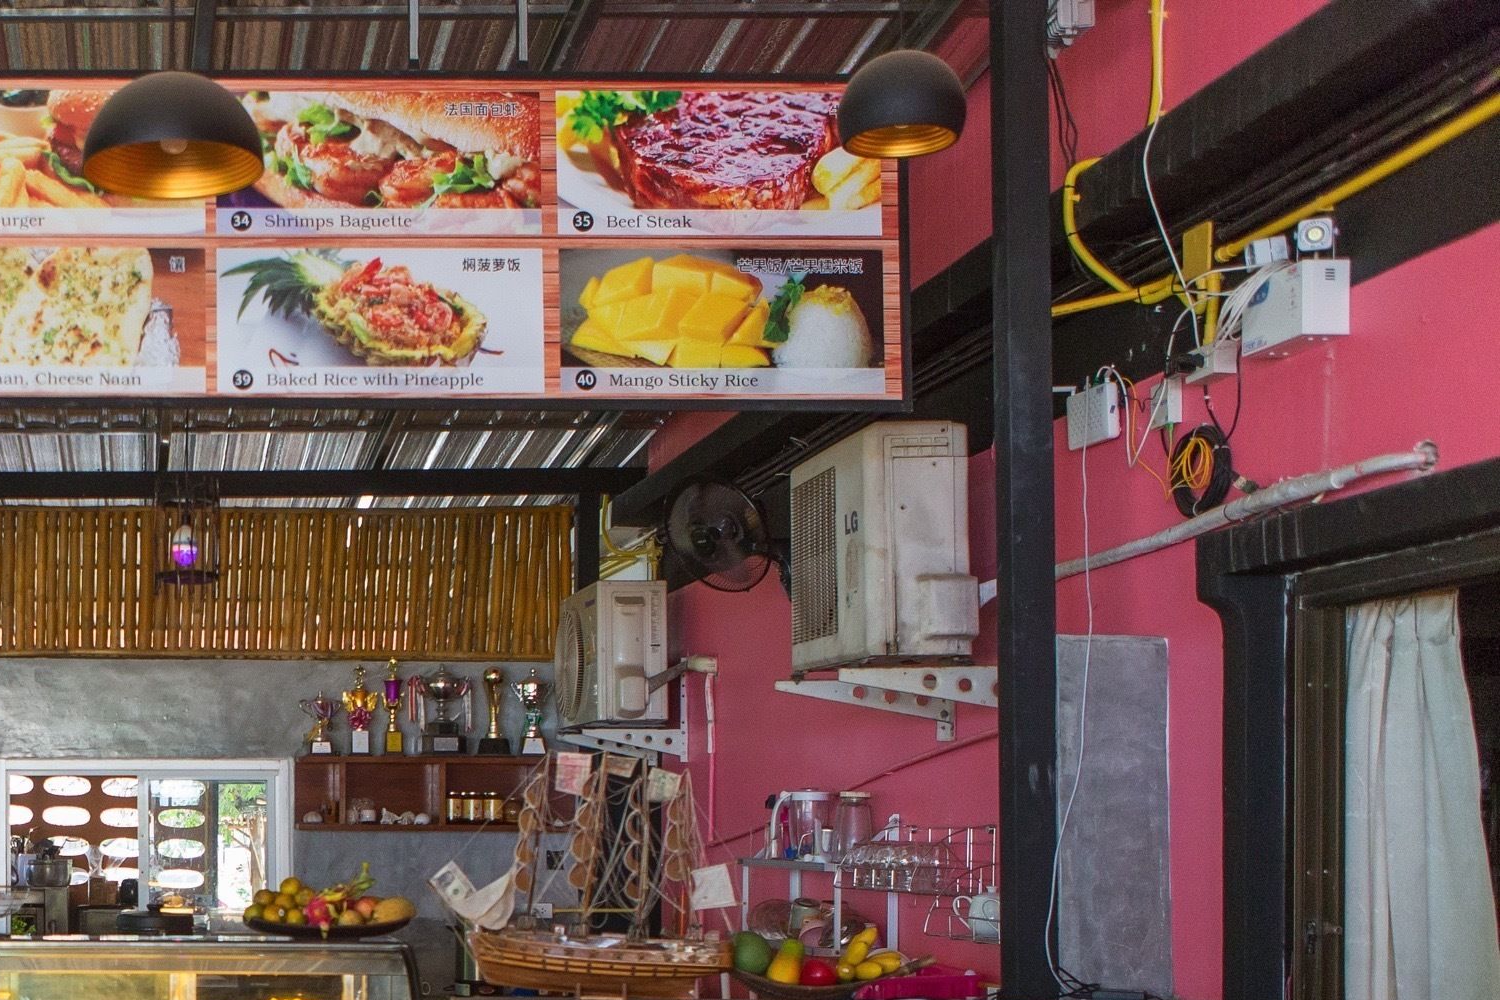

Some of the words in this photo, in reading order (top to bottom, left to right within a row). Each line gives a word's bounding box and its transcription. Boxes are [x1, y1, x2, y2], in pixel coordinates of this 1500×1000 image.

[445, 102, 517, 117] 法国面包虾
[232, 215, 251, 228] 34
[265, 214, 334, 231] Shrimps
[340, 214, 412, 231] Baguette
[574, 215, 592, 228] 35
[606, 214, 642, 228] Beef
[646, 214, 693, 228] Steak
[462, 258, 521, 272] 焖菠萝饭
[737, 258, 863, 274] 芒果饭/芒果糯米饭
[35, 371, 93, 386] Cheese
[99, 371, 142, 386] Naan
[234, 373, 252, 387] 39
[267, 372, 317, 387] Baked
[324, 372, 357, 387] Rice
[363, 372, 399, 387] with
[404, 372, 485, 390] Pineapple
[576, 374, 595, 387] 40
[609, 374, 663, 390] Mango
[668, 374, 718, 390] Sticky
[724, 374, 759, 388] Rice
[844, 509, 859, 536] LG
